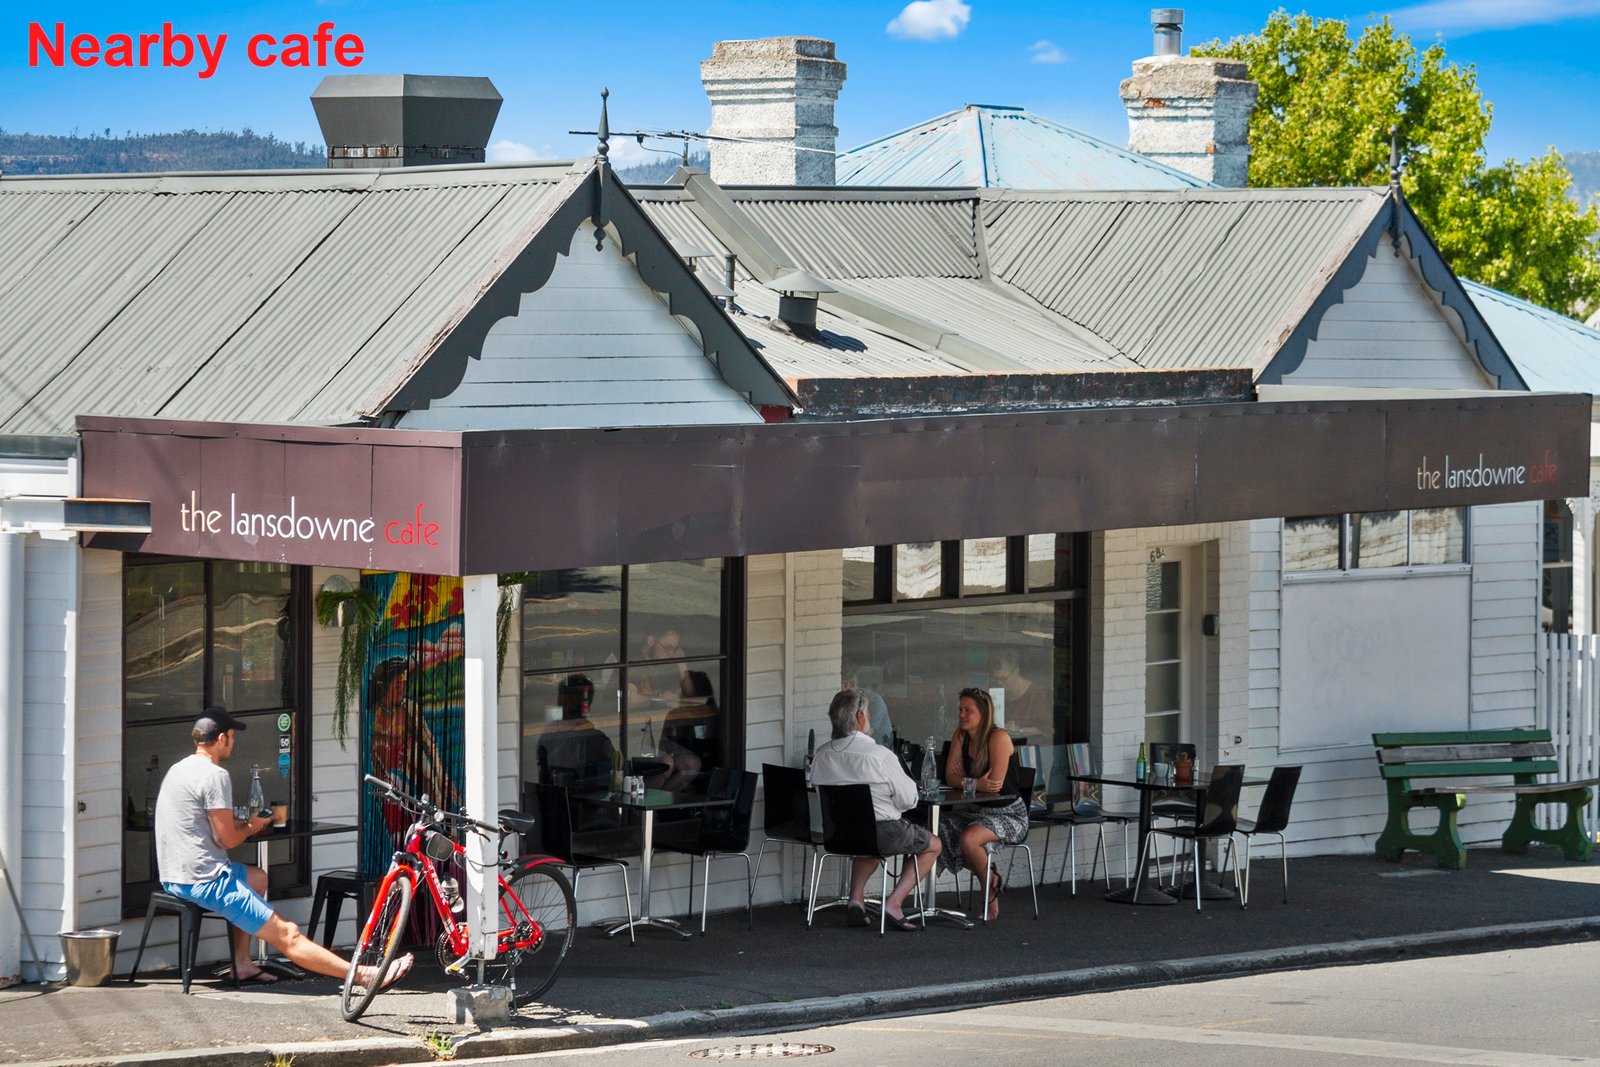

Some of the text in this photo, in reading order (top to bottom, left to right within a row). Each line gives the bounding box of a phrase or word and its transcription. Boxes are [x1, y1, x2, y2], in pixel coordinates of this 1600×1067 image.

[1417, 449, 1558, 490] the lansdowne cafe
[180, 490, 440, 547] the lansdowne cafe
